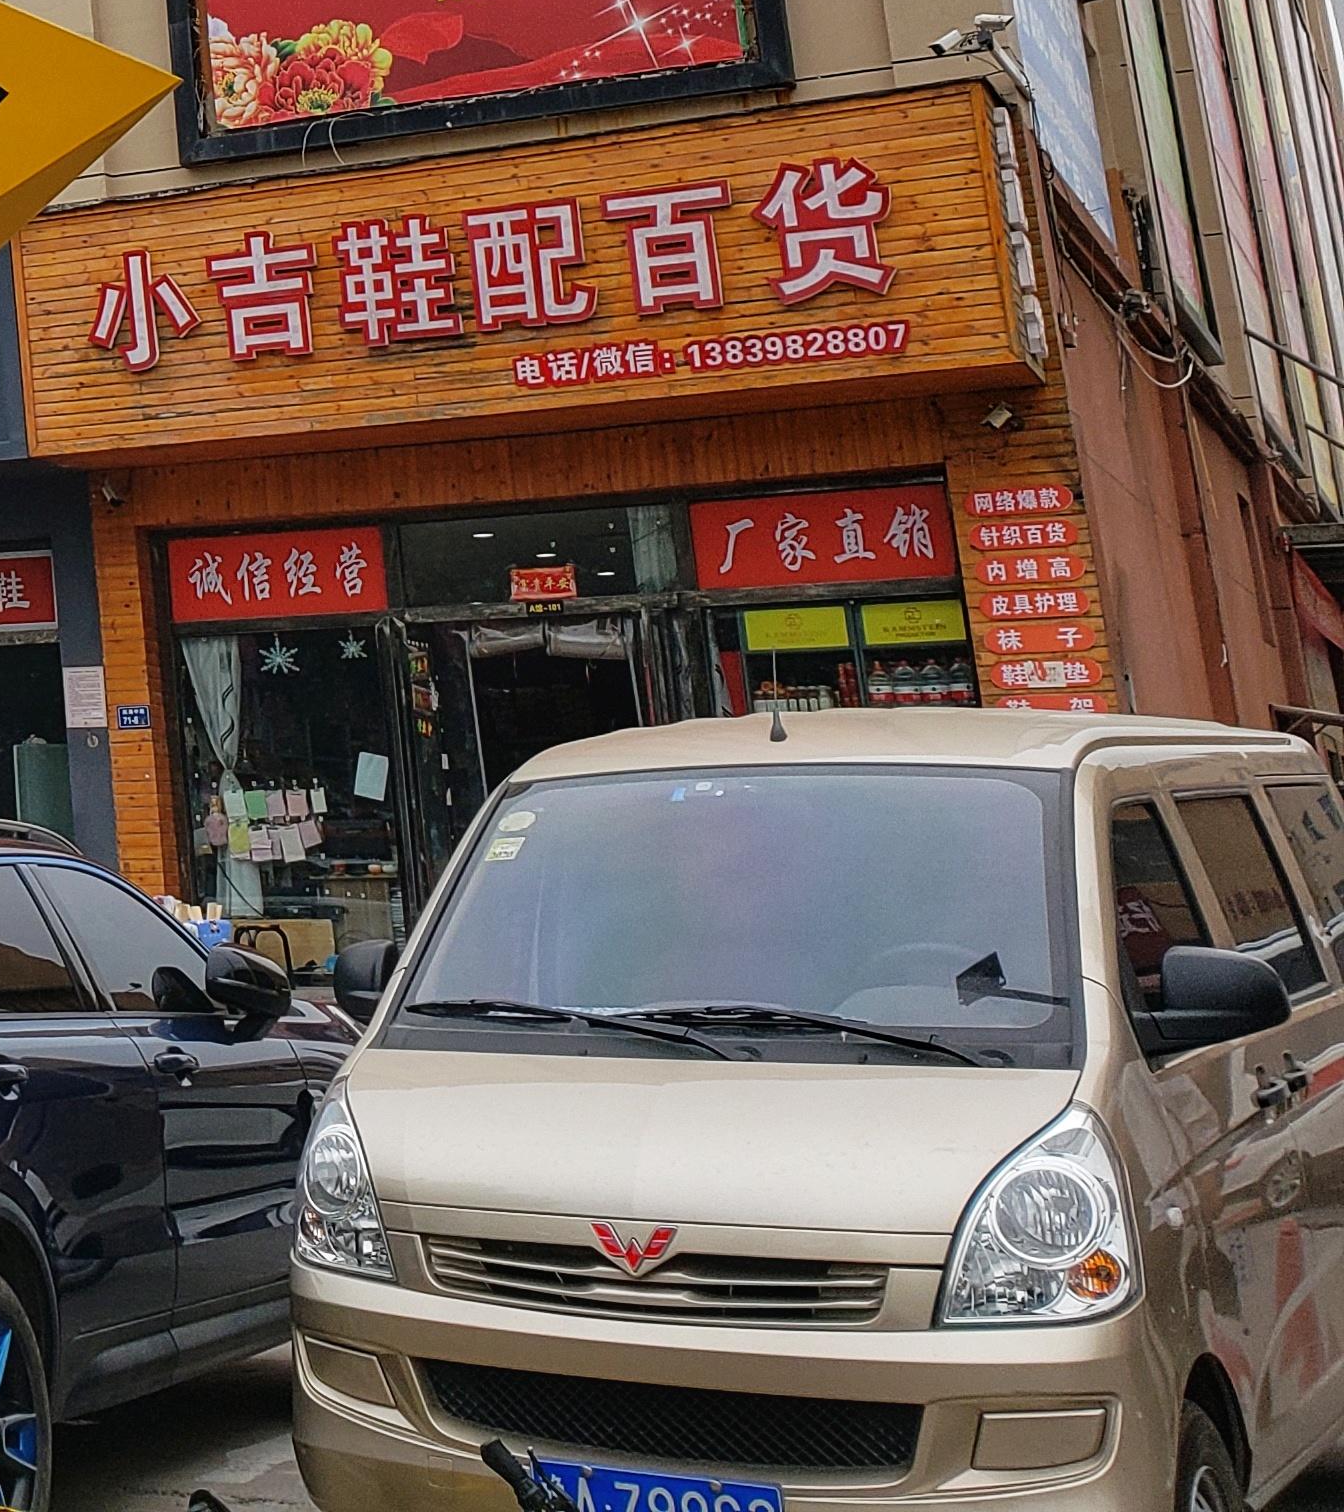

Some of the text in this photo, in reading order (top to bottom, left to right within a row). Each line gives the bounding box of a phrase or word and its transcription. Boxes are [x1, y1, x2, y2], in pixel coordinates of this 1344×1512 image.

[88, 157, 899, 372] 小吉鞋配百货
[685, 321, 909, 369] 13839828807
[974, 487, 1062, 514] 网络爆款
[718, 503, 935, 575] 厂家直销
[979, 522, 1068, 548] 针织百货
[187, 541, 369, 606] 诚信经营
[986, 555, 1072, 582] 内增高
[991, 591, 1080, 616] 皮具护理
